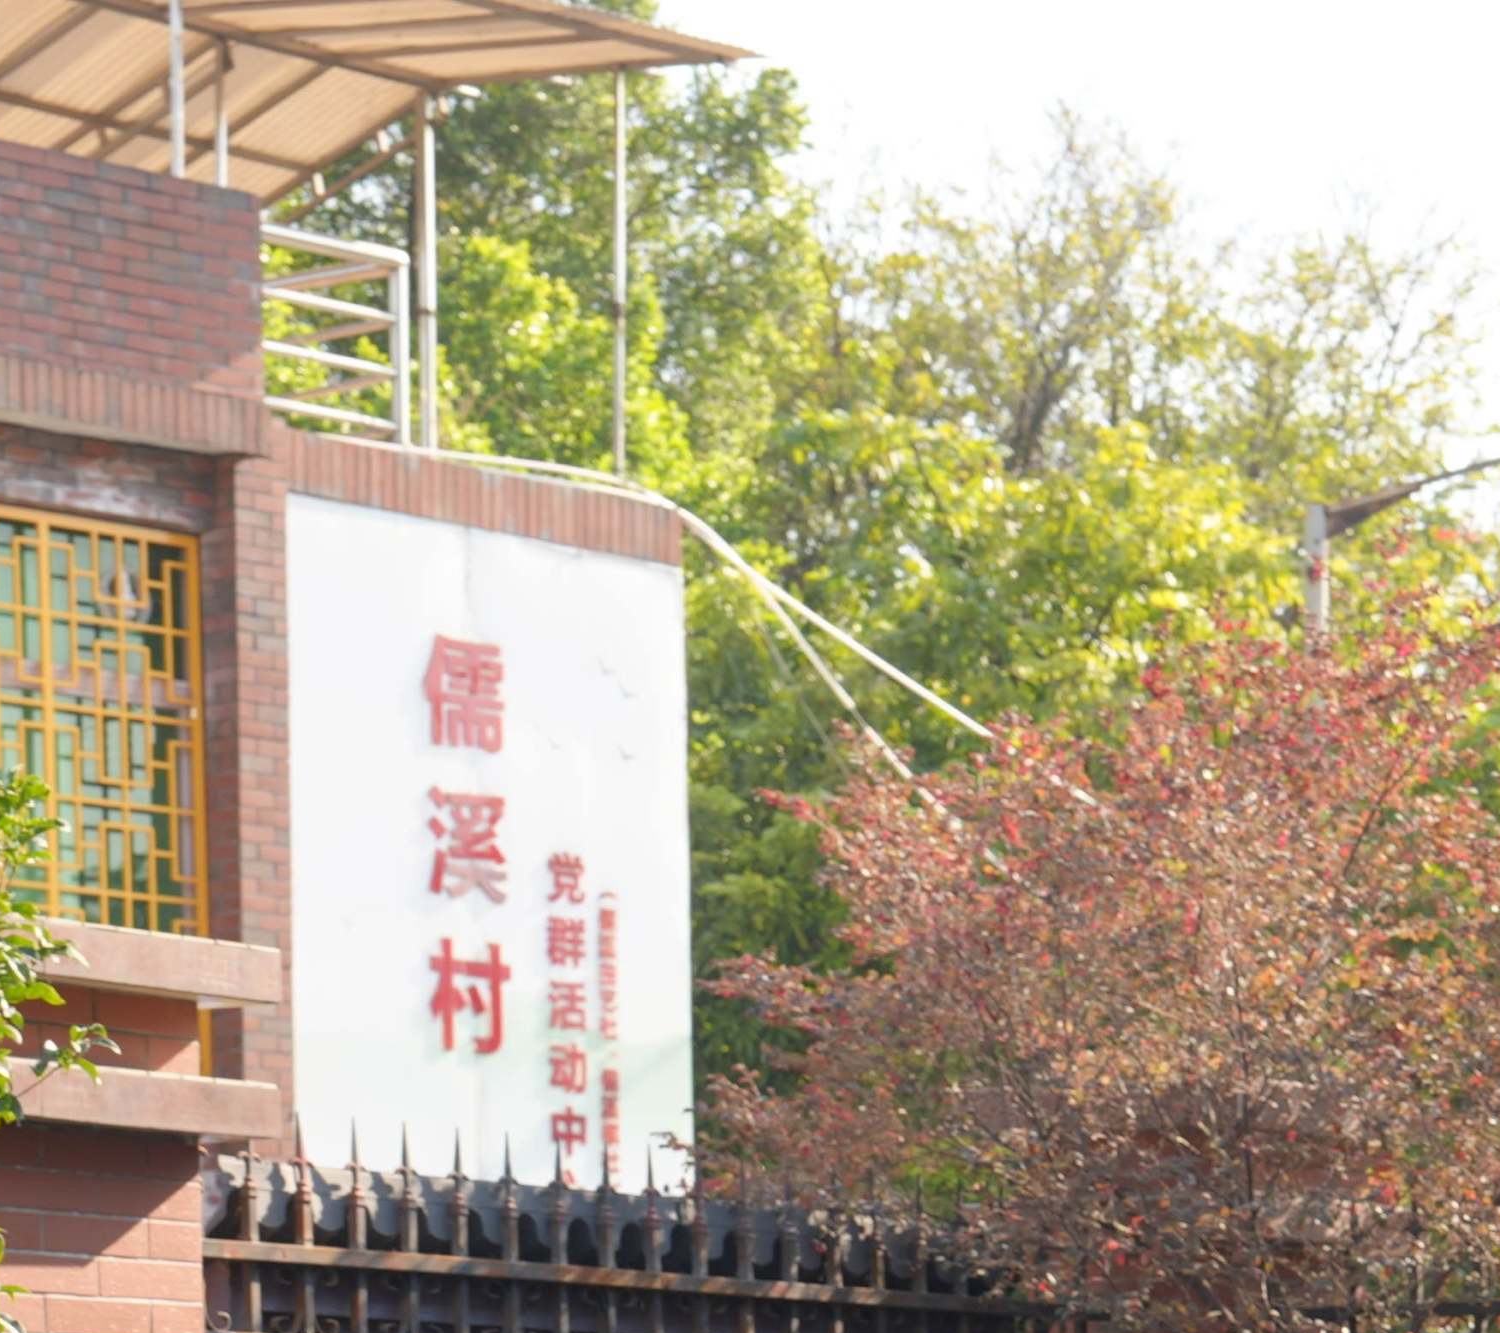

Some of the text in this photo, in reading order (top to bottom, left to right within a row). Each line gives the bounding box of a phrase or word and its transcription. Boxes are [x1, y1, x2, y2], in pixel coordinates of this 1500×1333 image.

[422, 633, 511, 1056] 儒溪村
[547, 852, 588, 1186] 党群活动中
